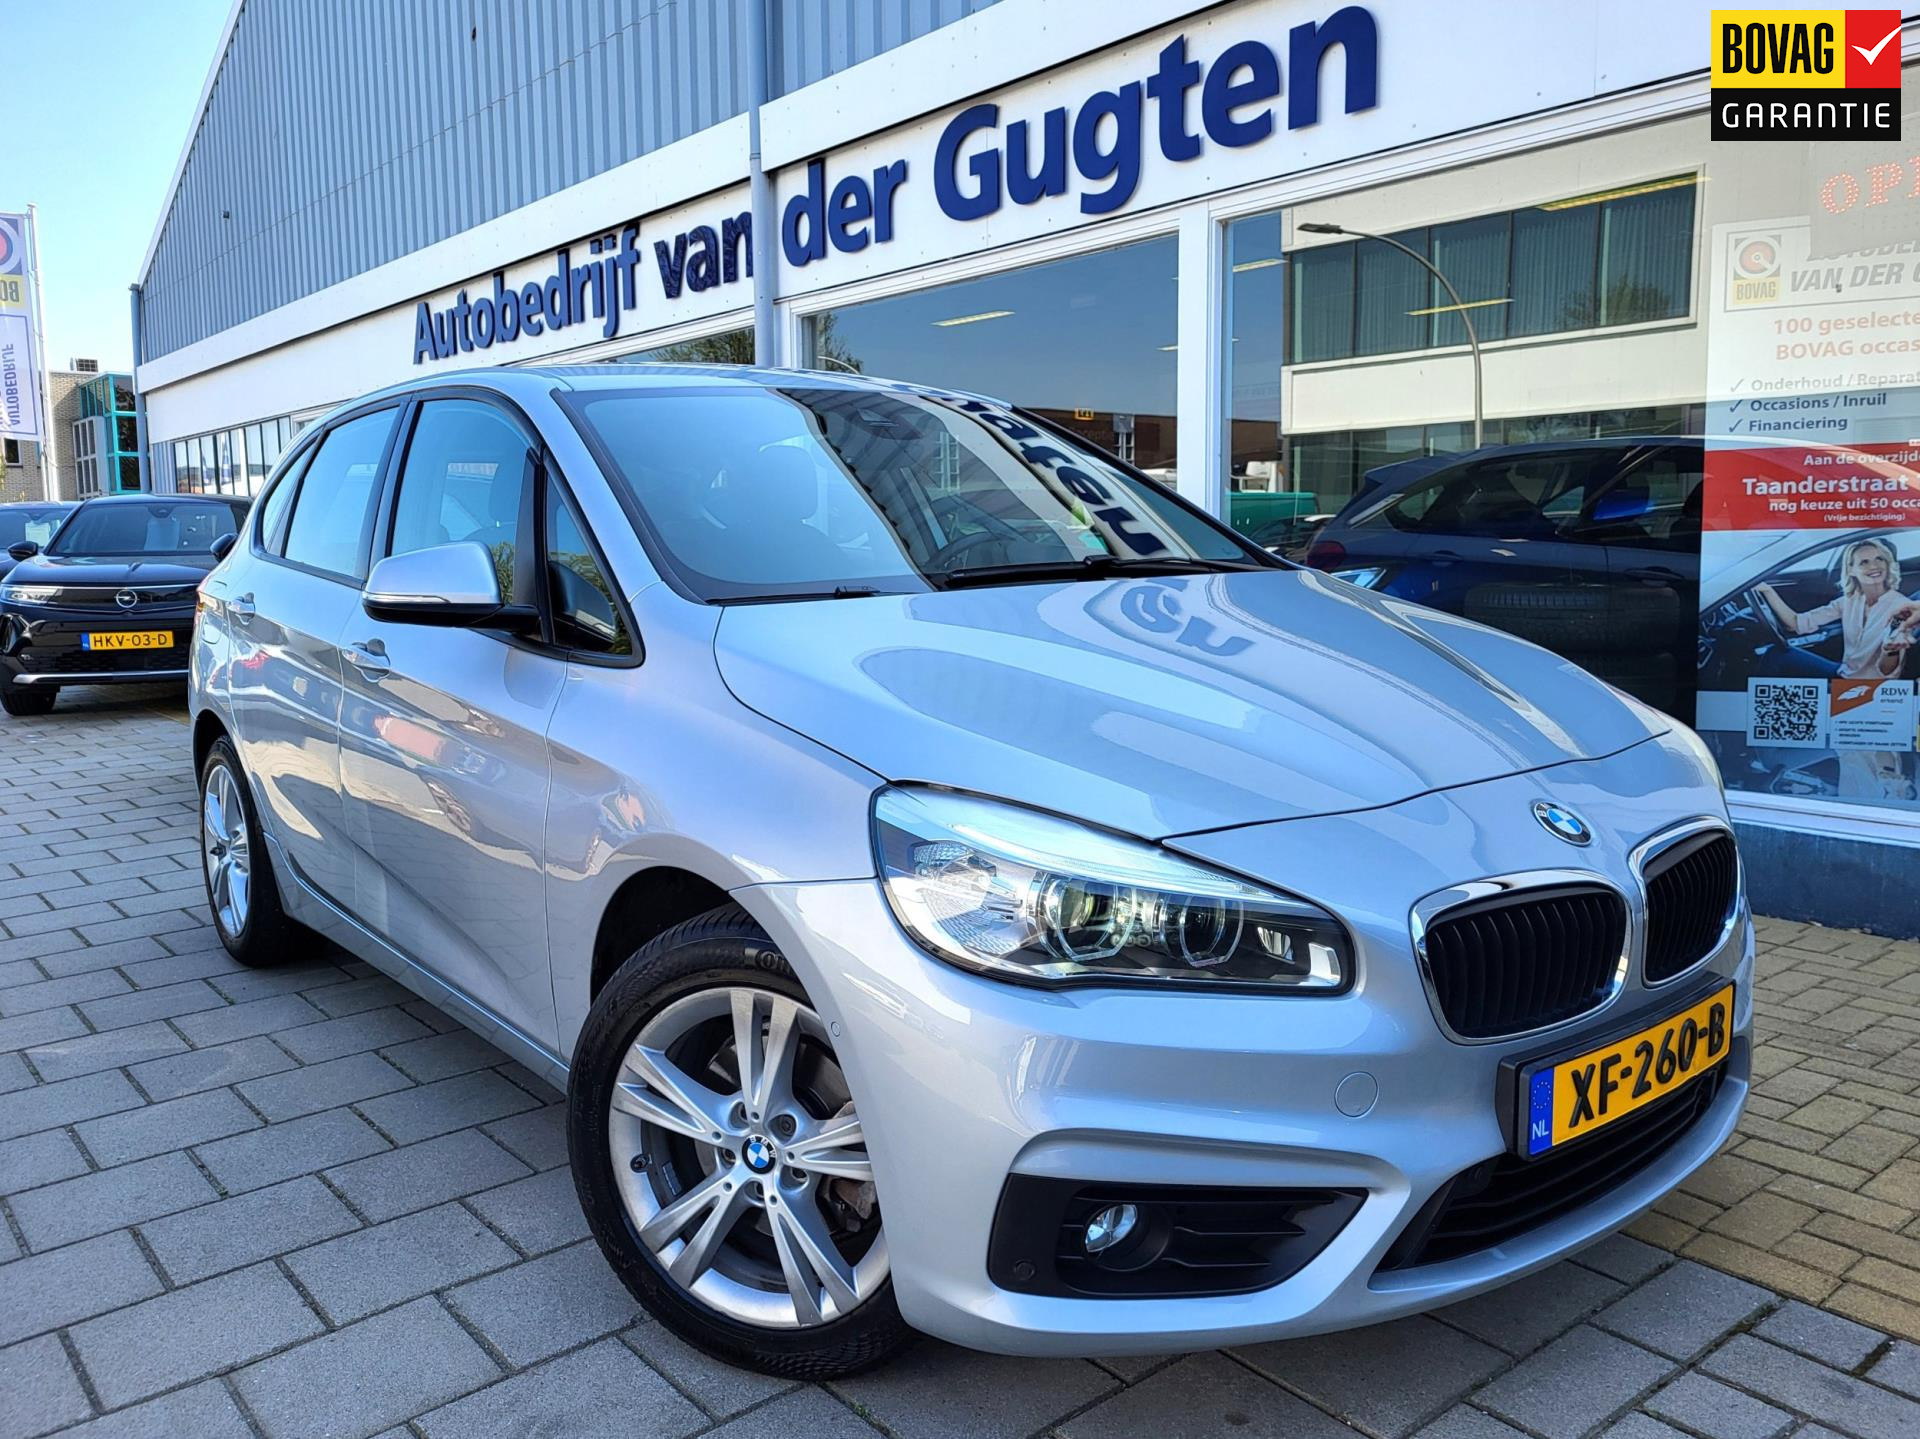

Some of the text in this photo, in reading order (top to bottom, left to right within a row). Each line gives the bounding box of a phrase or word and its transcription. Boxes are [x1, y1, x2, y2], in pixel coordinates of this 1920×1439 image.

[413, 5, 1378, 364] Autobedrijf van der Gugten
[1790, 267, 1843, 291] VAN
[1849, 262, 1905, 288] DER
[1736, 281, 1777, 301] BOVAG
[1774, 317, 1812, 335] 100
[1776, 340, 1854, 361] BOVAG
[1751, 373, 1844, 392] Onderhoud
[1750, 397, 1829, 412] Occasions
[1843, 393, 1887, 407] Inruil
[1749, 416, 1848, 432] Financiering
[1804, 450, 1920, 465] Aan de overzijd
[1742, 474, 1909, 496] Taanderstraat
[1769, 501, 1797, 513] nog
[1800, 499, 1843, 511] keuze
[1847, 498, 1866, 509] uit
[1870, 497, 1888, 509] 50
[93, 633, 168, 647] HKV-03-D
[1881, 687, 1909, 697] RDW
[1532, 1002, 1725, 1141] NL XF-260-B
